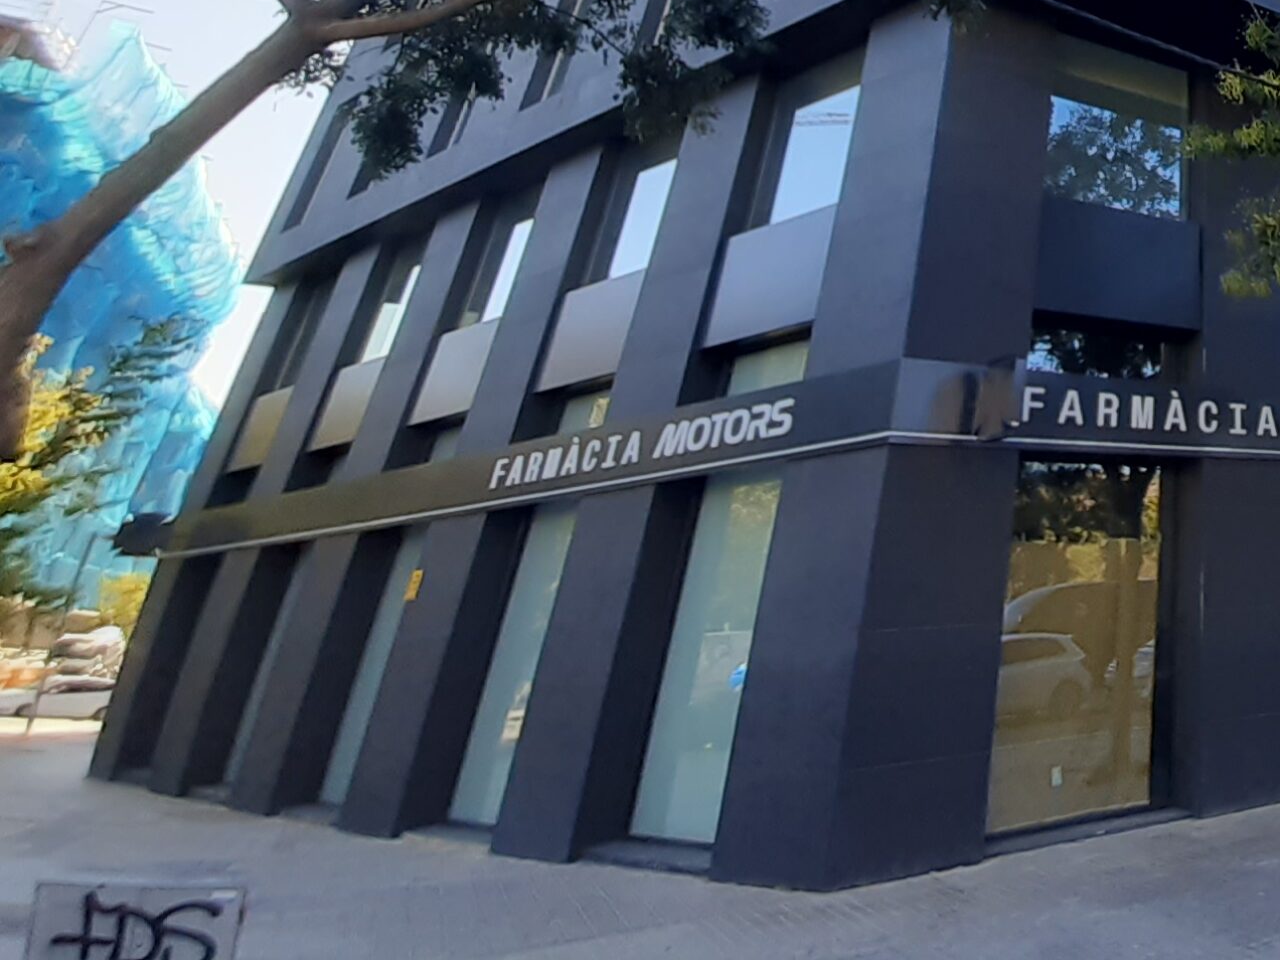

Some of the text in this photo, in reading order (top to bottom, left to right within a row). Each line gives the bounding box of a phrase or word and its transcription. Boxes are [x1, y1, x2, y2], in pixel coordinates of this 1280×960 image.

[488, 397, 796, 491] FARMÀCIA MOTORS
[1021, 386, 1279, 438] FARMÀCIA
